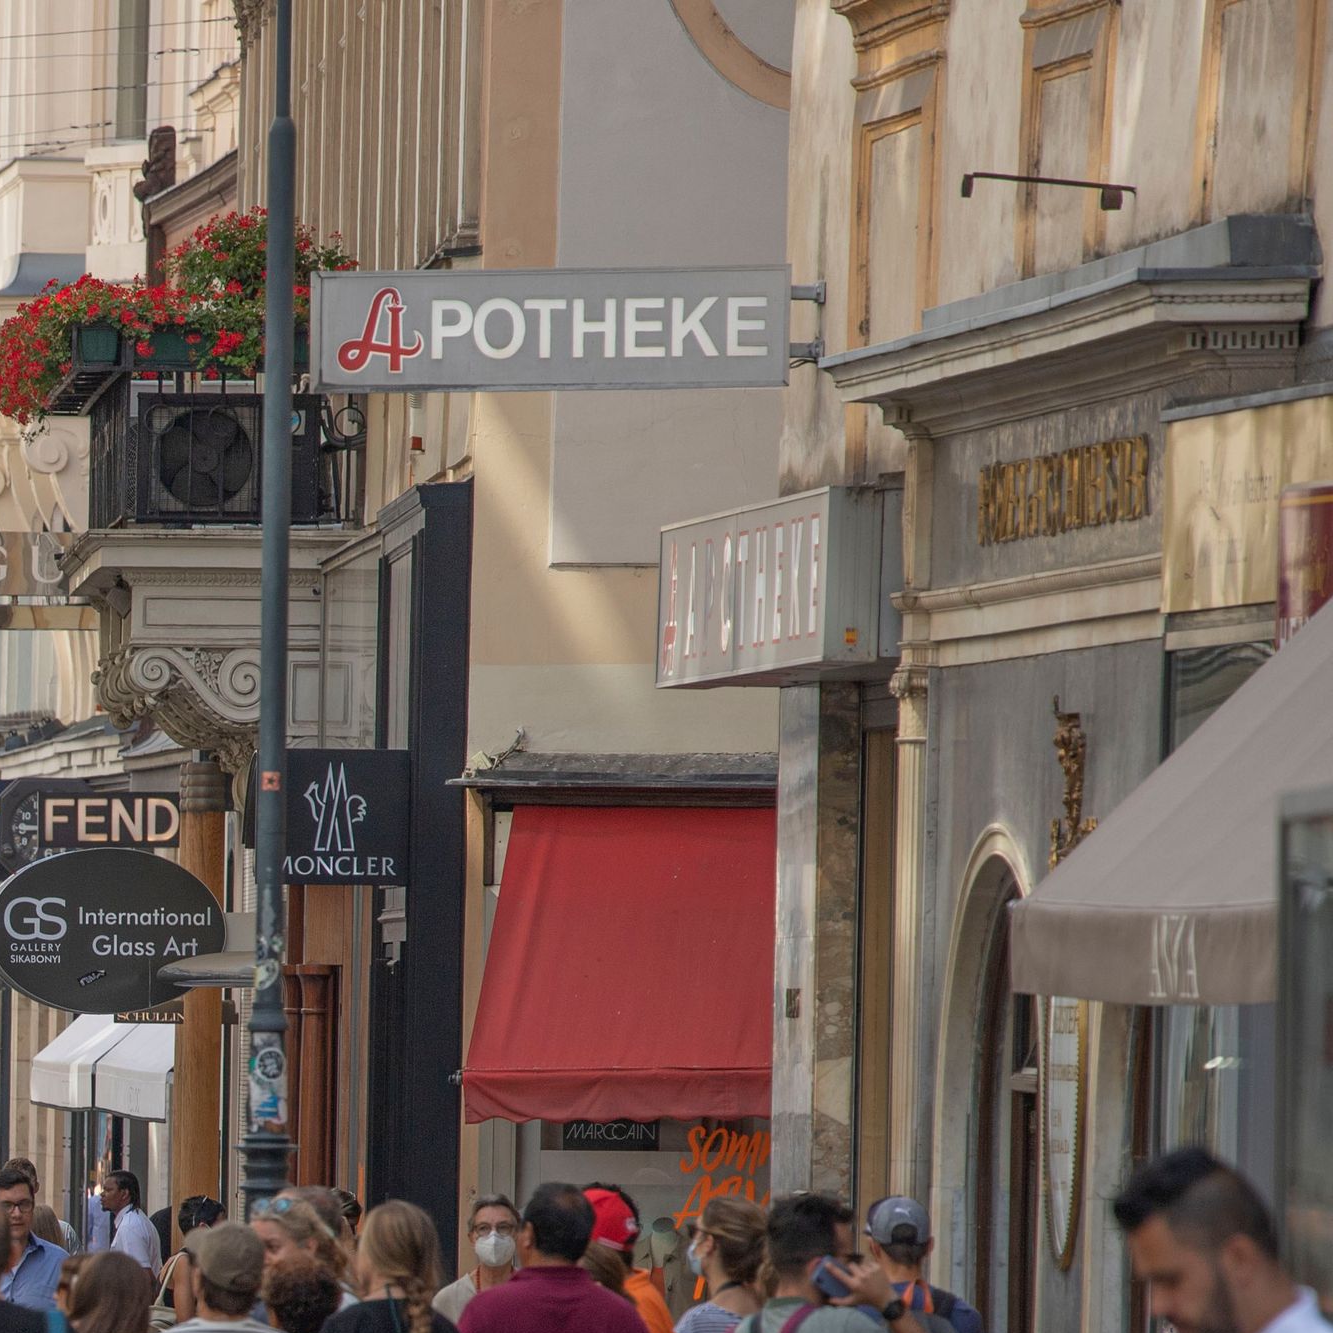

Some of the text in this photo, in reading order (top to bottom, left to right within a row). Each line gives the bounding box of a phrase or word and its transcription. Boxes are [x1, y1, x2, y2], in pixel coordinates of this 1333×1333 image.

[337, 286, 768, 374] APOTHEKE
[684, 512, 821, 660] APOTHEKE
[44, 798, 179, 842] FEND
[3, 897, 211, 941] GS International
[10, 935, 199, 957] GALLERY Glass Art
[10, 954, 61, 964] SIKABONYI
